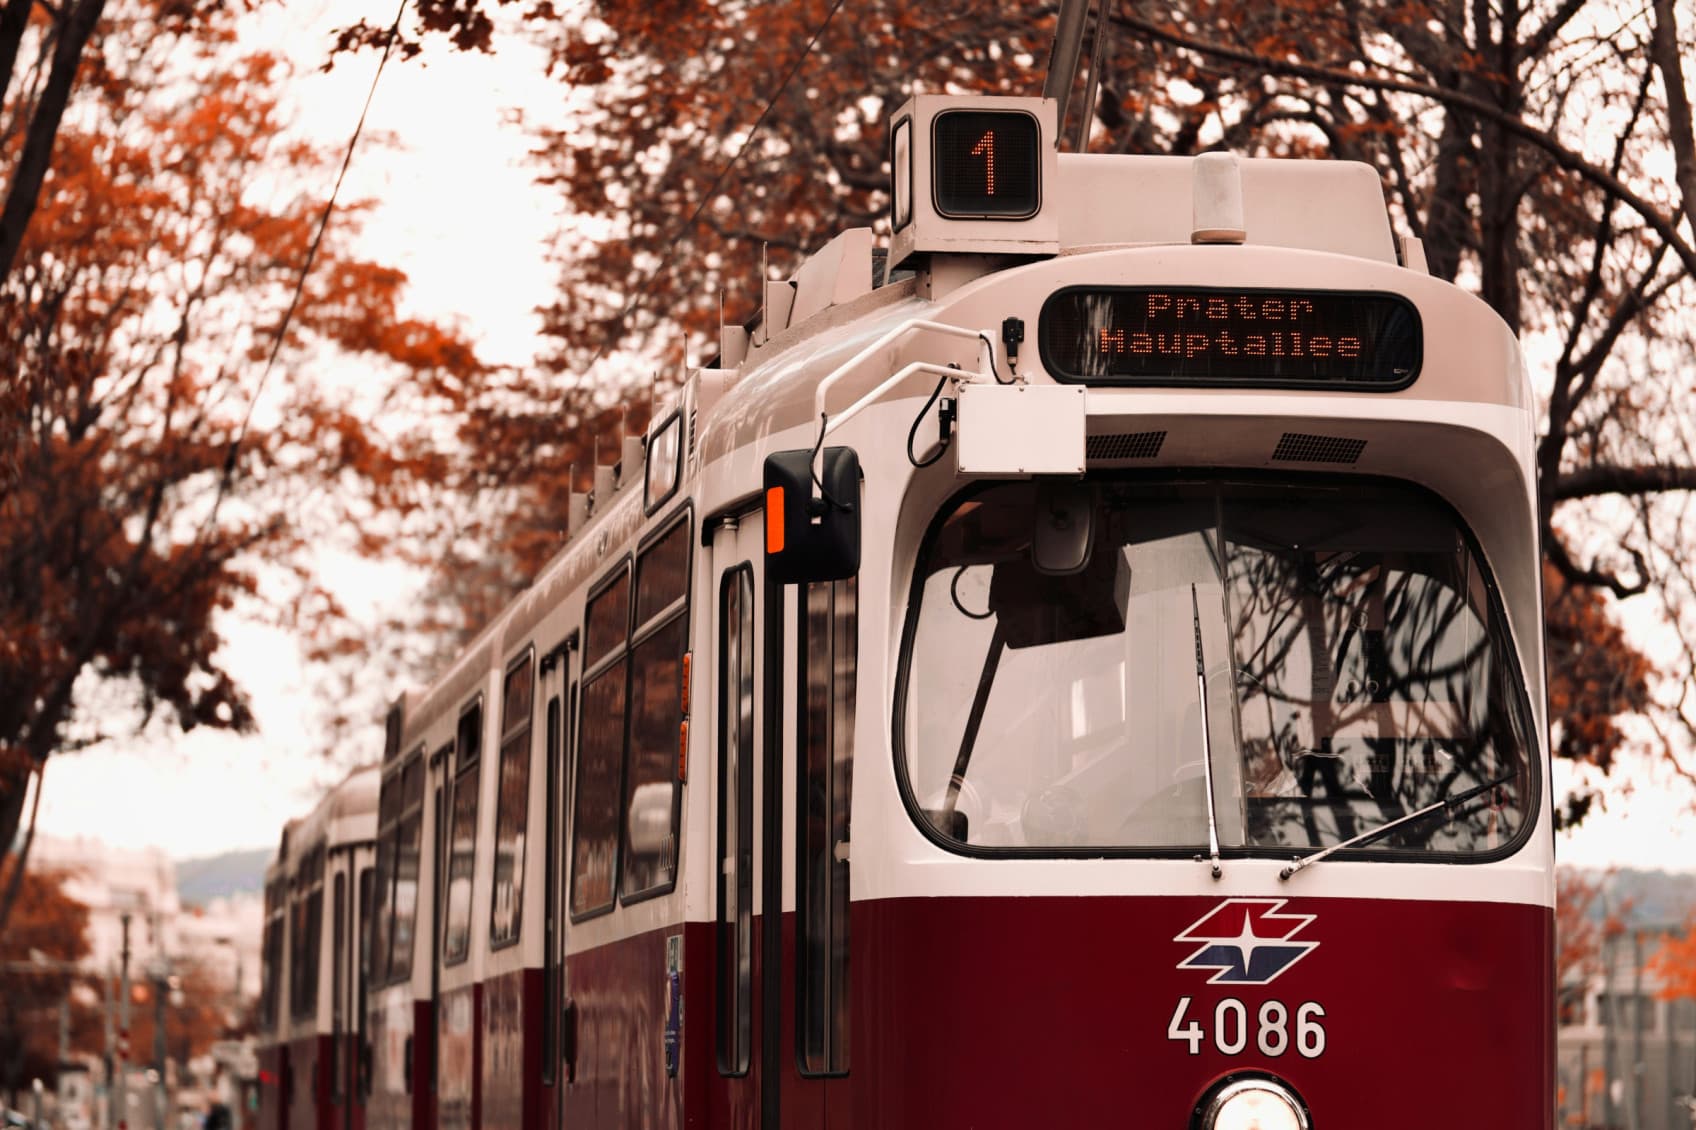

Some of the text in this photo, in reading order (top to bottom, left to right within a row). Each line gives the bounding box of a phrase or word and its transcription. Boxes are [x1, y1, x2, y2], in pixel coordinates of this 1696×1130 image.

[970, 129, 995, 196] 1
[1148, 294, 1313, 320] Prater
[1100, 329, 1360, 358] Hauptallee
[1167, 996, 1327, 1059] 4086
